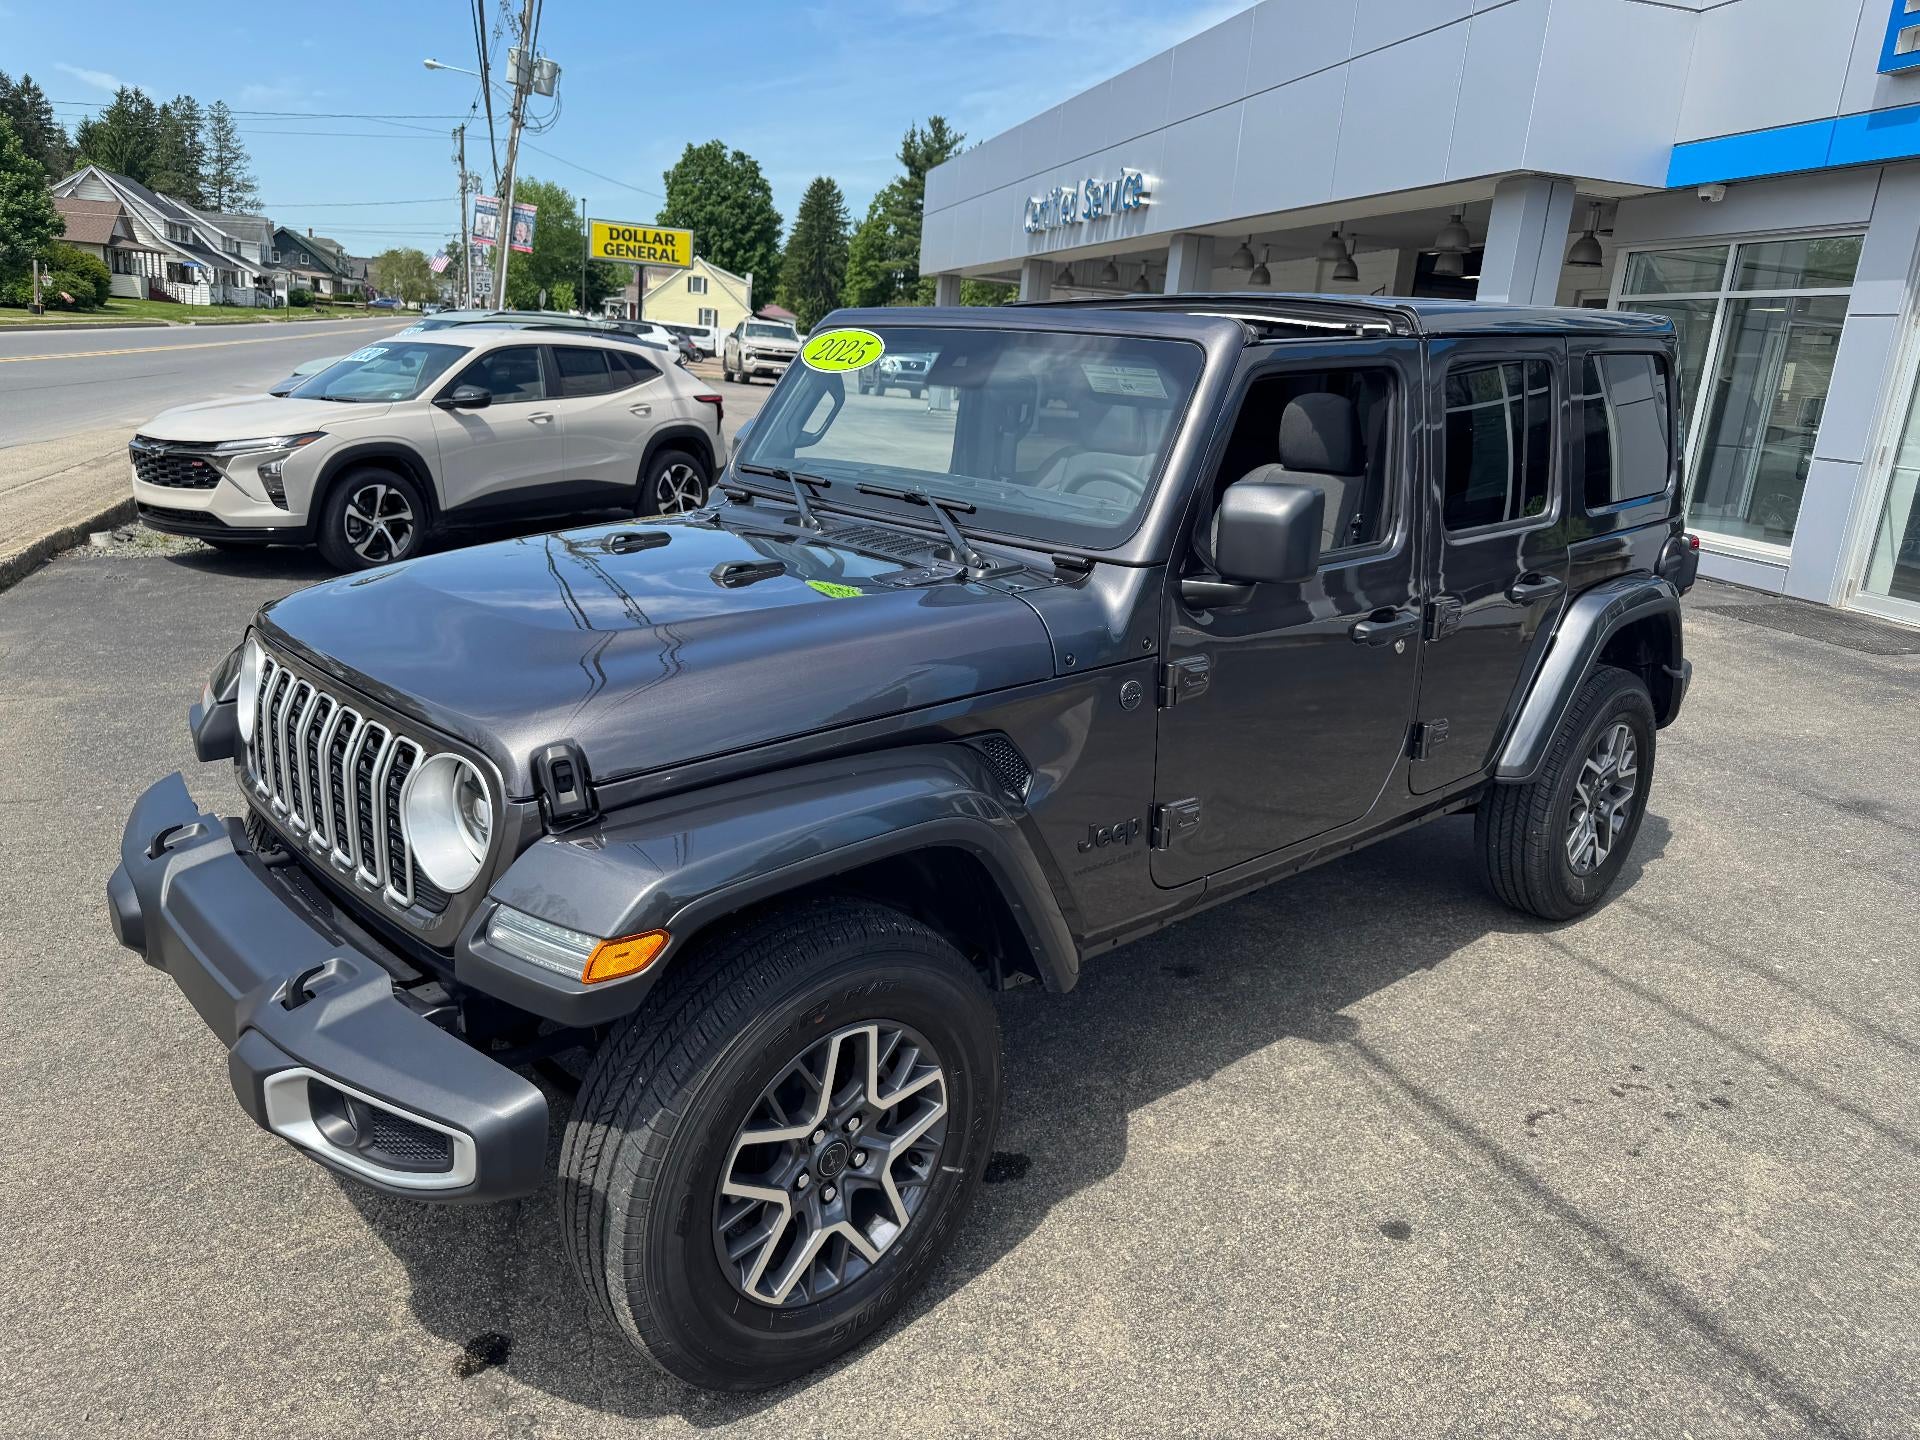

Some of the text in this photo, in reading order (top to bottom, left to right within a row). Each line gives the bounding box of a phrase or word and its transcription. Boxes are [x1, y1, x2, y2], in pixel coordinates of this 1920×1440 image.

[1023, 168, 1145, 234] Certified Service
[608, 227, 676, 247] DOLLAR
[603, 242, 680, 263] GENERAL
[476, 282, 491, 292] 35
[810, 338, 874, 365] 2025
[1077, 818, 1139, 853] Jeep
